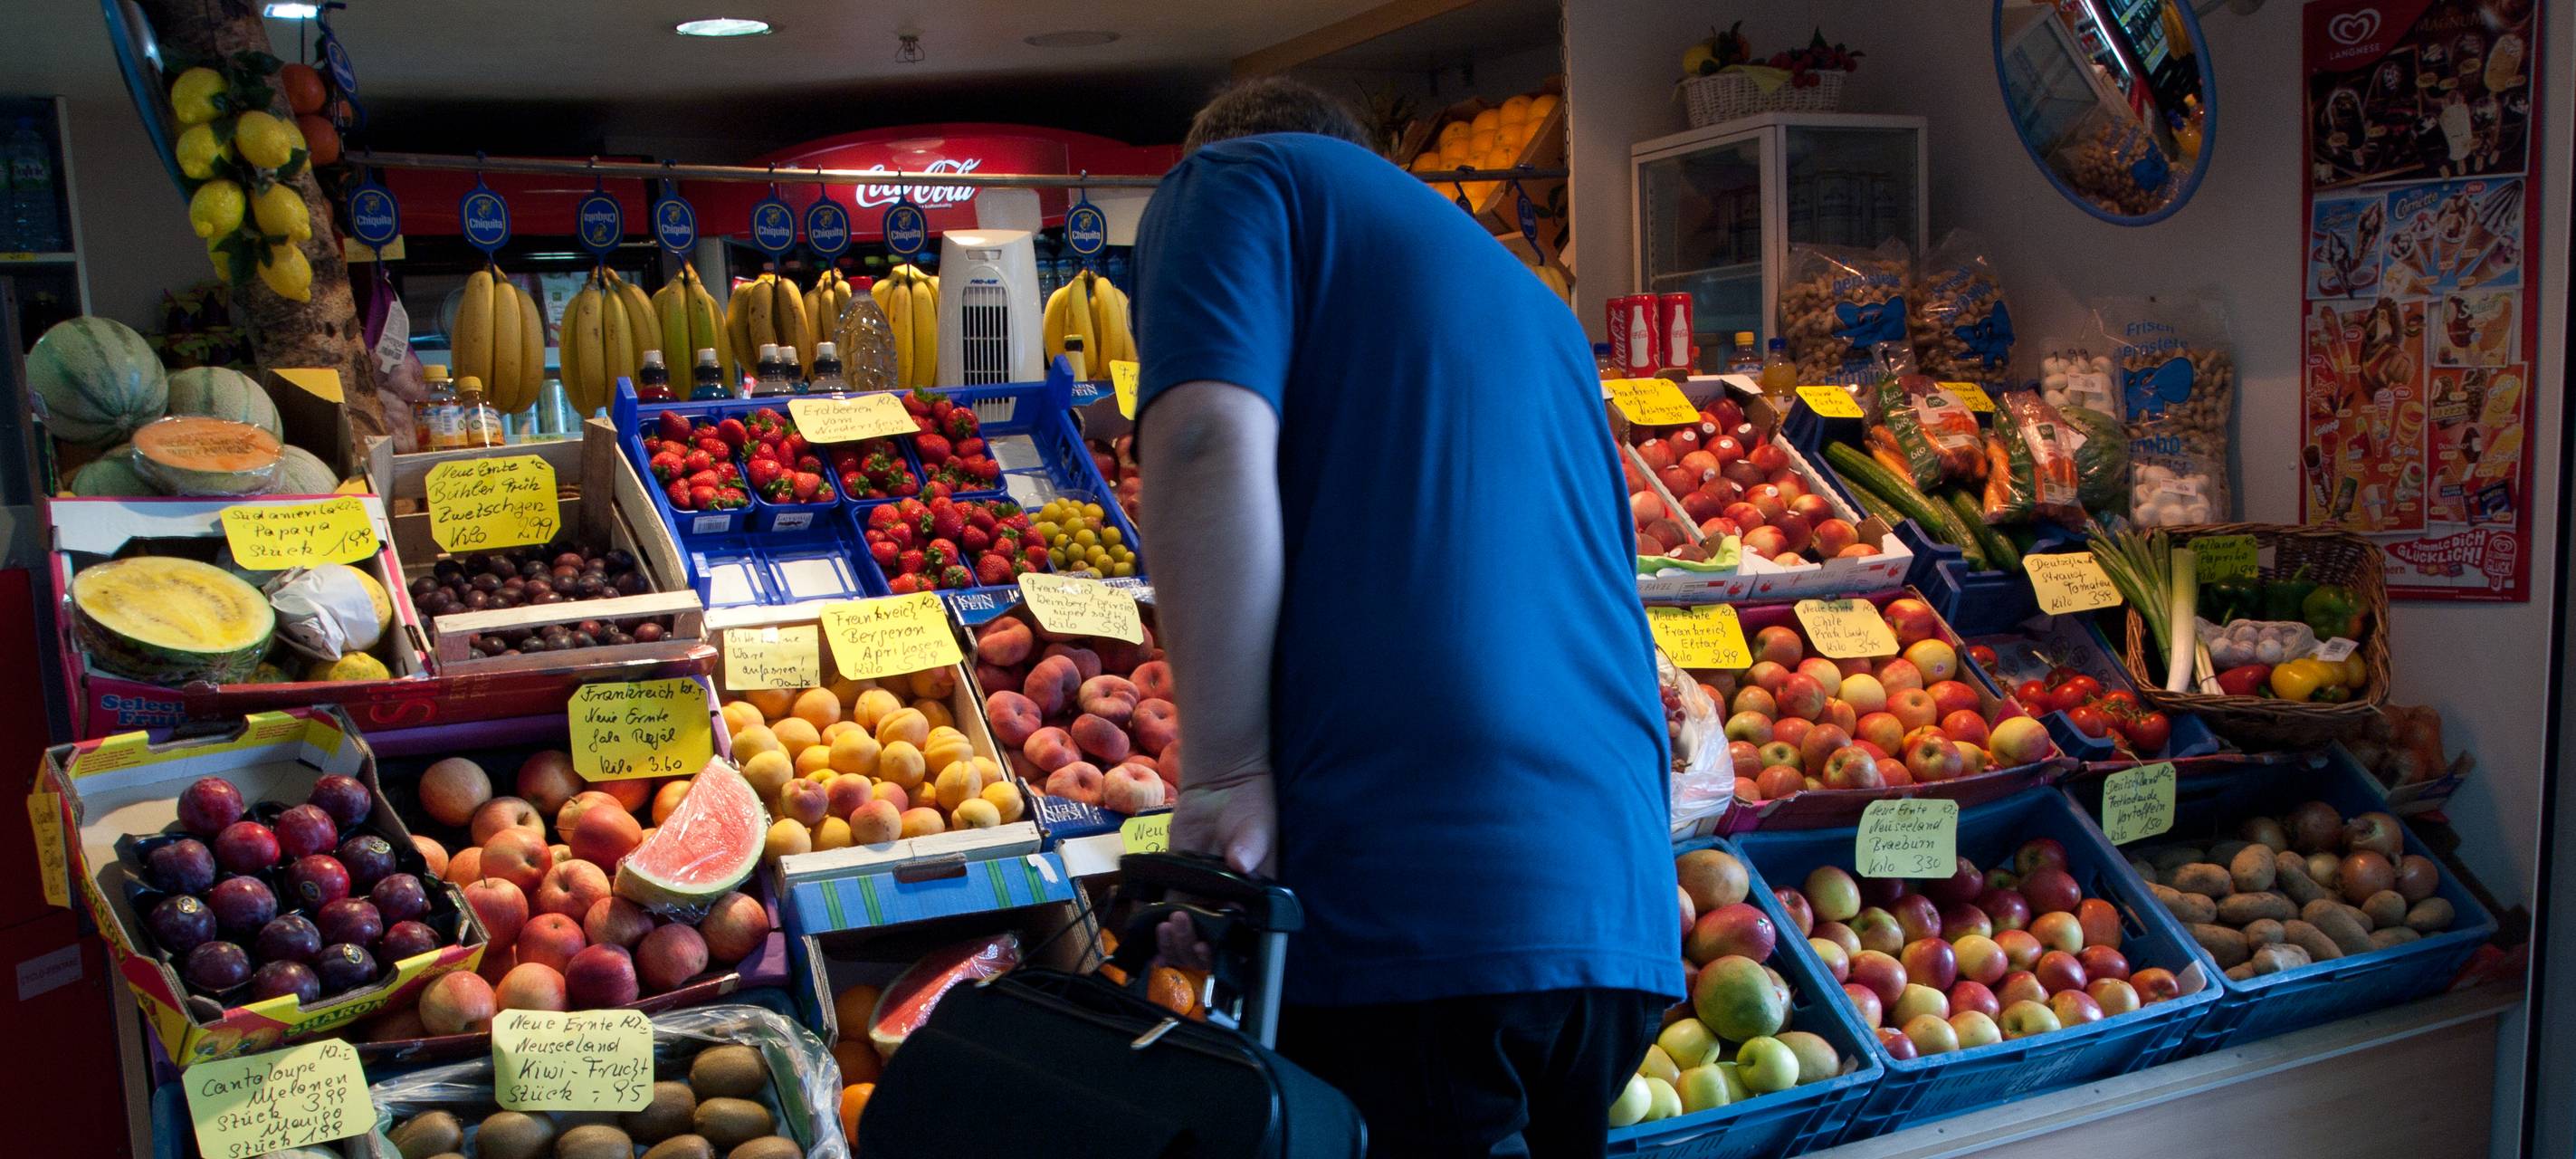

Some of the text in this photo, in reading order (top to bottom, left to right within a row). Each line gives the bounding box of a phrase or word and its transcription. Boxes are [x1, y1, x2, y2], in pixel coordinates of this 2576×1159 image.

[2329, 43, 2382, 61] LANGNESE
[356, 214, 393, 228] Chiquita
[468, 217, 503, 231] Chiquita
[583, 210, 616, 225] Chiquita
[661, 222, 691, 236] Chiquita
[758, 225, 790, 238] Chiquita
[812, 227, 844, 241] Chiquita
[890, 228, 921, 241] Chiquita
[1071, 228, 1102, 241] Chiquita
[436, 465, 473, 481] Neue
[243, 522, 331, 540] Papaya
[450, 525, 487, 548] Kilo
[250, 541, 315, 558] Stück
[2064, 577, 2111, 595] Tomaten
[2051, 596, 2073, 610] Kilo
[1659, 621, 1727, 637] Frankreich
[863, 638, 948, 662] Aprikosen
[1681, 637, 1719, 649] Elstar
[732, 647, 764, 660] Ware
[1672, 650, 1693, 662] Kilo
[854, 661, 883, 677] Kilo
[580, 683, 674, 702] Frankreich
[625, 707, 669, 724] Ernte
[600, 755, 633, 775] Kilo
[1897, 802, 1927, 816] Ernte
[1133, 822, 1170, 841] Neu
[1869, 818, 1944, 834] Neuseeland
[1869, 834, 1935, 852] Braeburn
[1867, 856, 1895, 875] Kilo
[281, 997, 391, 1039] SHARON
[509, 1014, 556, 1030] Neue
[563, 1016, 614, 1033] Ernte
[515, 1033, 621, 1055] Neuseeland
[201, 1062, 317, 1097] Cantaloupe
[246, 1074, 348, 1109] Melonen
[507, 1079, 573, 1103] Stück
[217, 1101, 281, 1132] Stück
[228, 1131, 291, 1159] Stück
